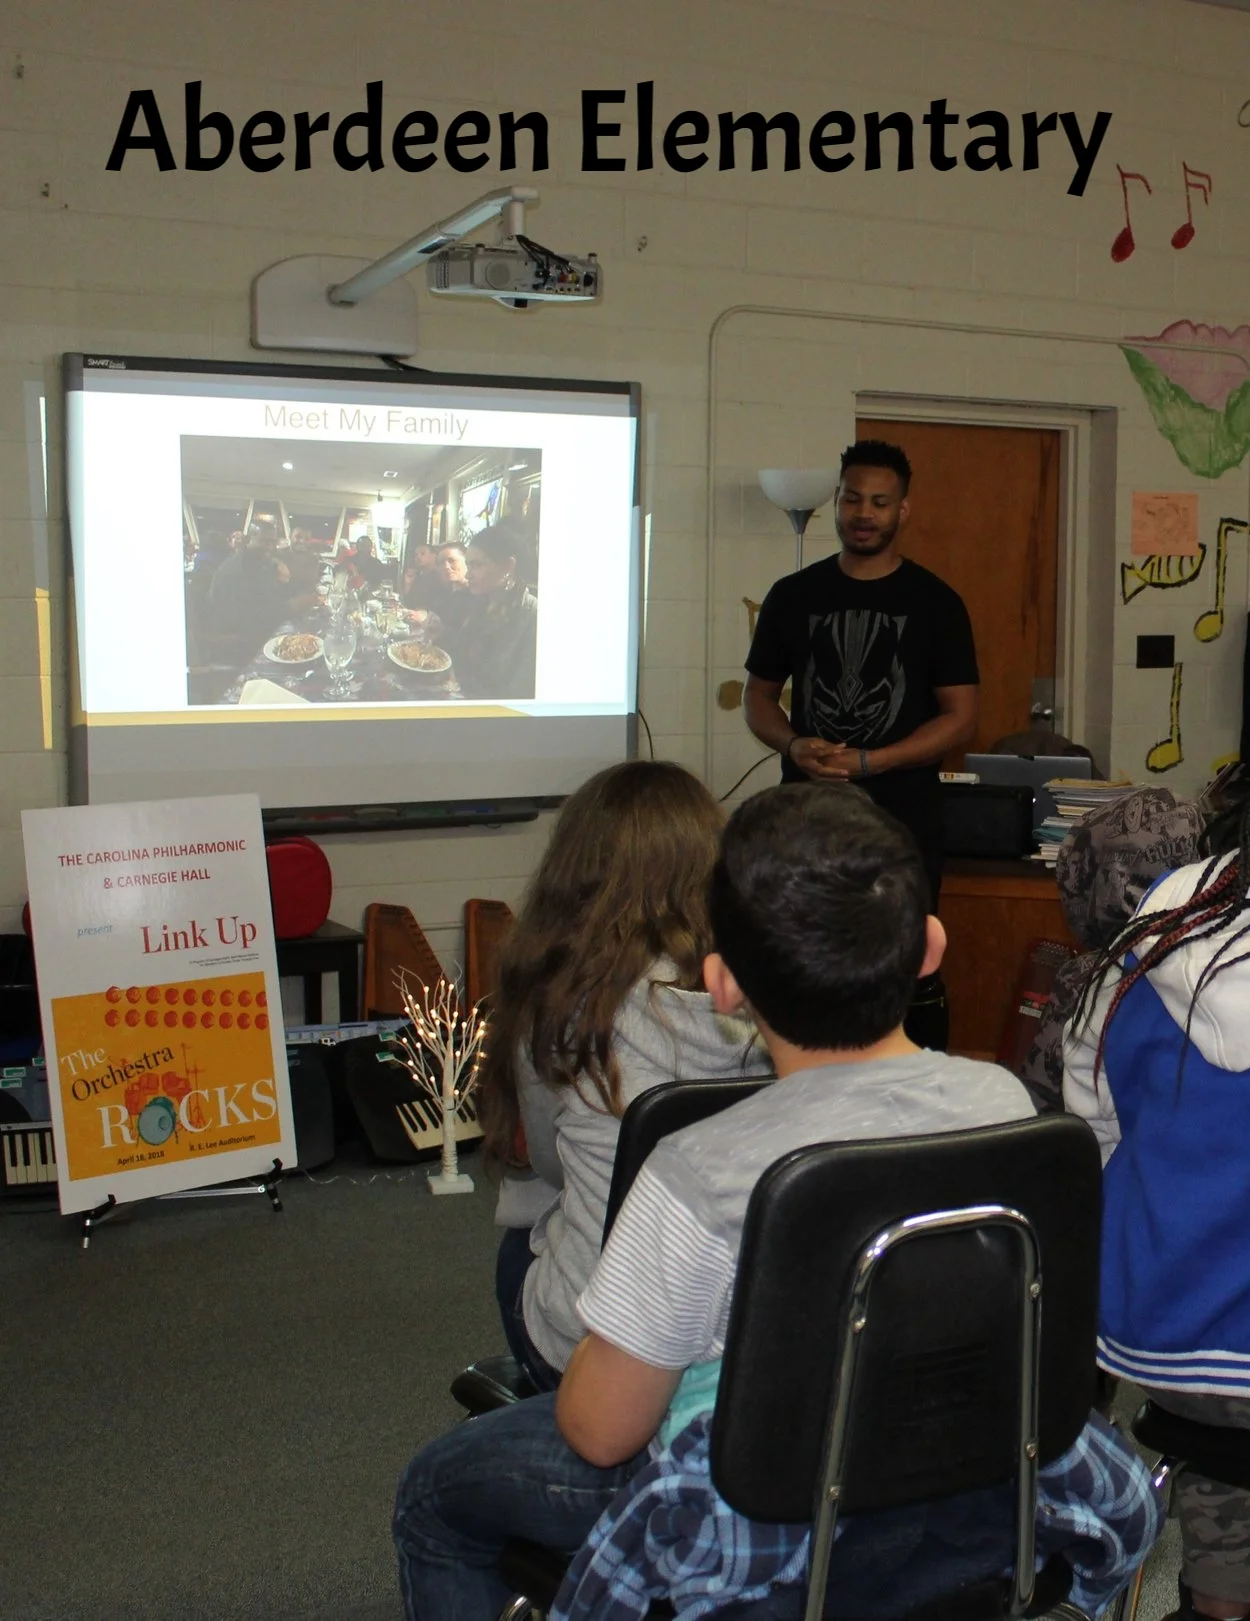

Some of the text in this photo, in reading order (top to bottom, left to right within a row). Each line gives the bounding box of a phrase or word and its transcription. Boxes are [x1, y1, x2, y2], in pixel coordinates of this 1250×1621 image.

[87, 358, 110, 366] SMART
[264, 404, 469, 441] Meet My Family
[58, 839, 247, 868] THE CAROLINA PHILHARMONIC
[103, 868, 211, 889] & CARNEGIE HALL
[77, 915, 257, 954] present Link Up
[60, 1047, 108, 1077] The
[71, 1046, 175, 1101] Orchestra
[205, 1140, 217, 1149] Lee
[218, 1135, 256, 1146] Auditorium
[117, 1151, 134, 1166] April
[147, 1149, 165, 1161] 2018
